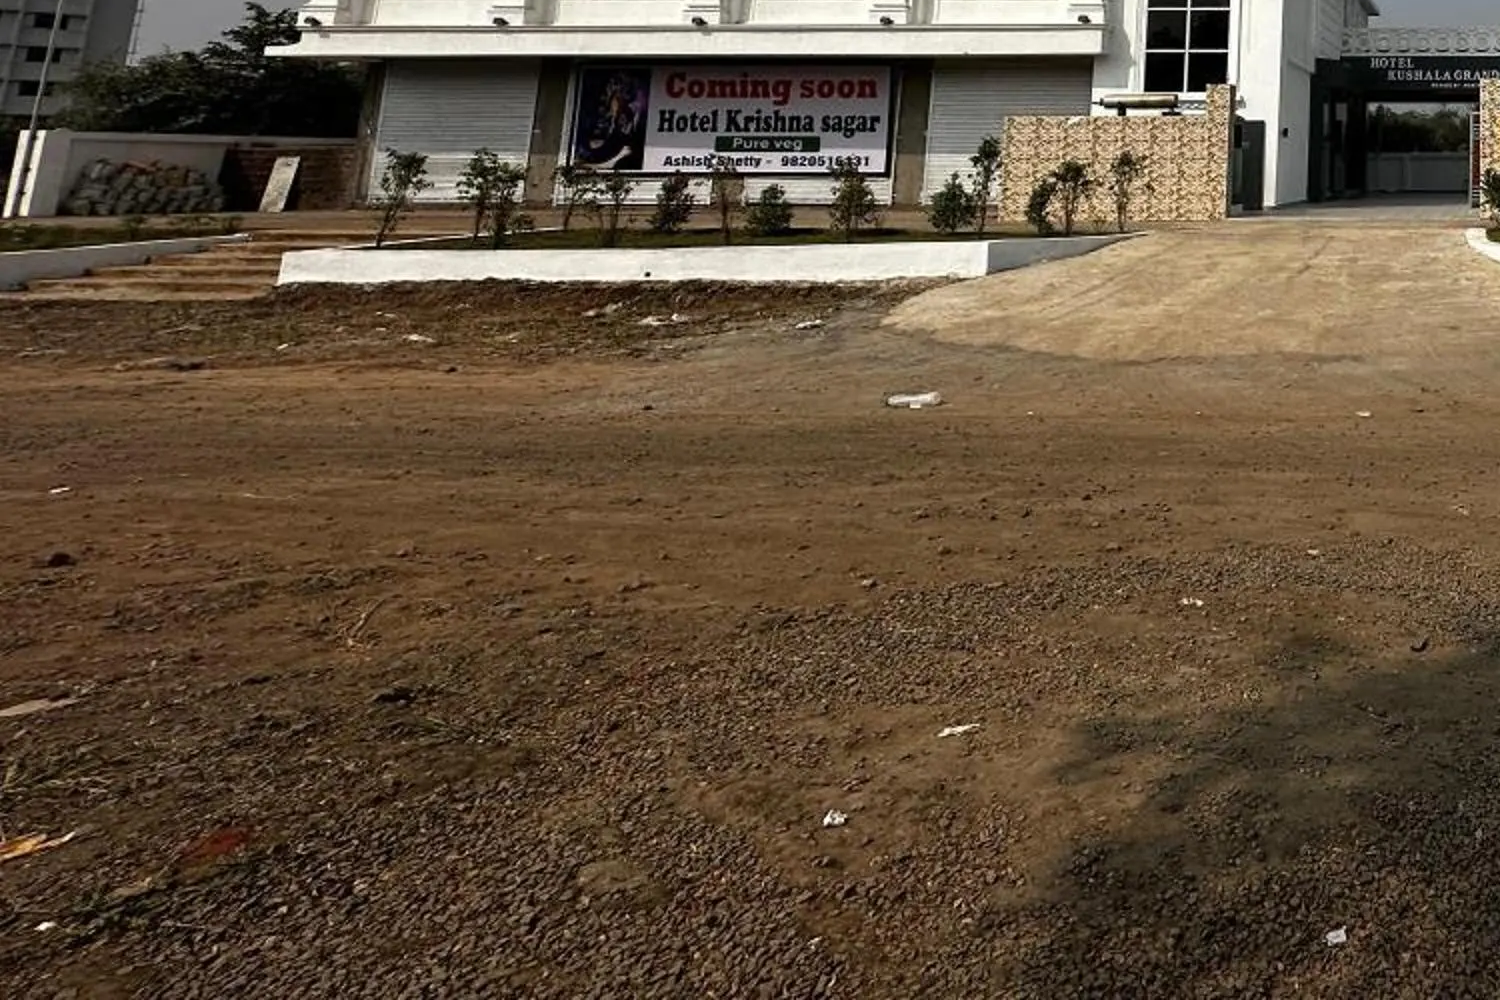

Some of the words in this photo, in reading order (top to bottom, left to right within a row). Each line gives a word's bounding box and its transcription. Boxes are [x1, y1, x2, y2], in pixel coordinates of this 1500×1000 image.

[1370, 57, 1415, 69] HOTEL
[1388, 69, 1451, 81] KUSHALA
[1453, 69, 1500, 81] GRAND
[666, 71, 792, 106] Coming
[801, 79, 878, 99] soon
[657, 108, 719, 133] Hotel
[725, 108, 815, 133] Krishna
[820, 114, 881, 139] sagar
[732, 137, 770, 149] Pure
[773, 139, 803, 151] veg
[663, 155, 714, 167] Ashish
[716, 155, 762, 169] Shetty
